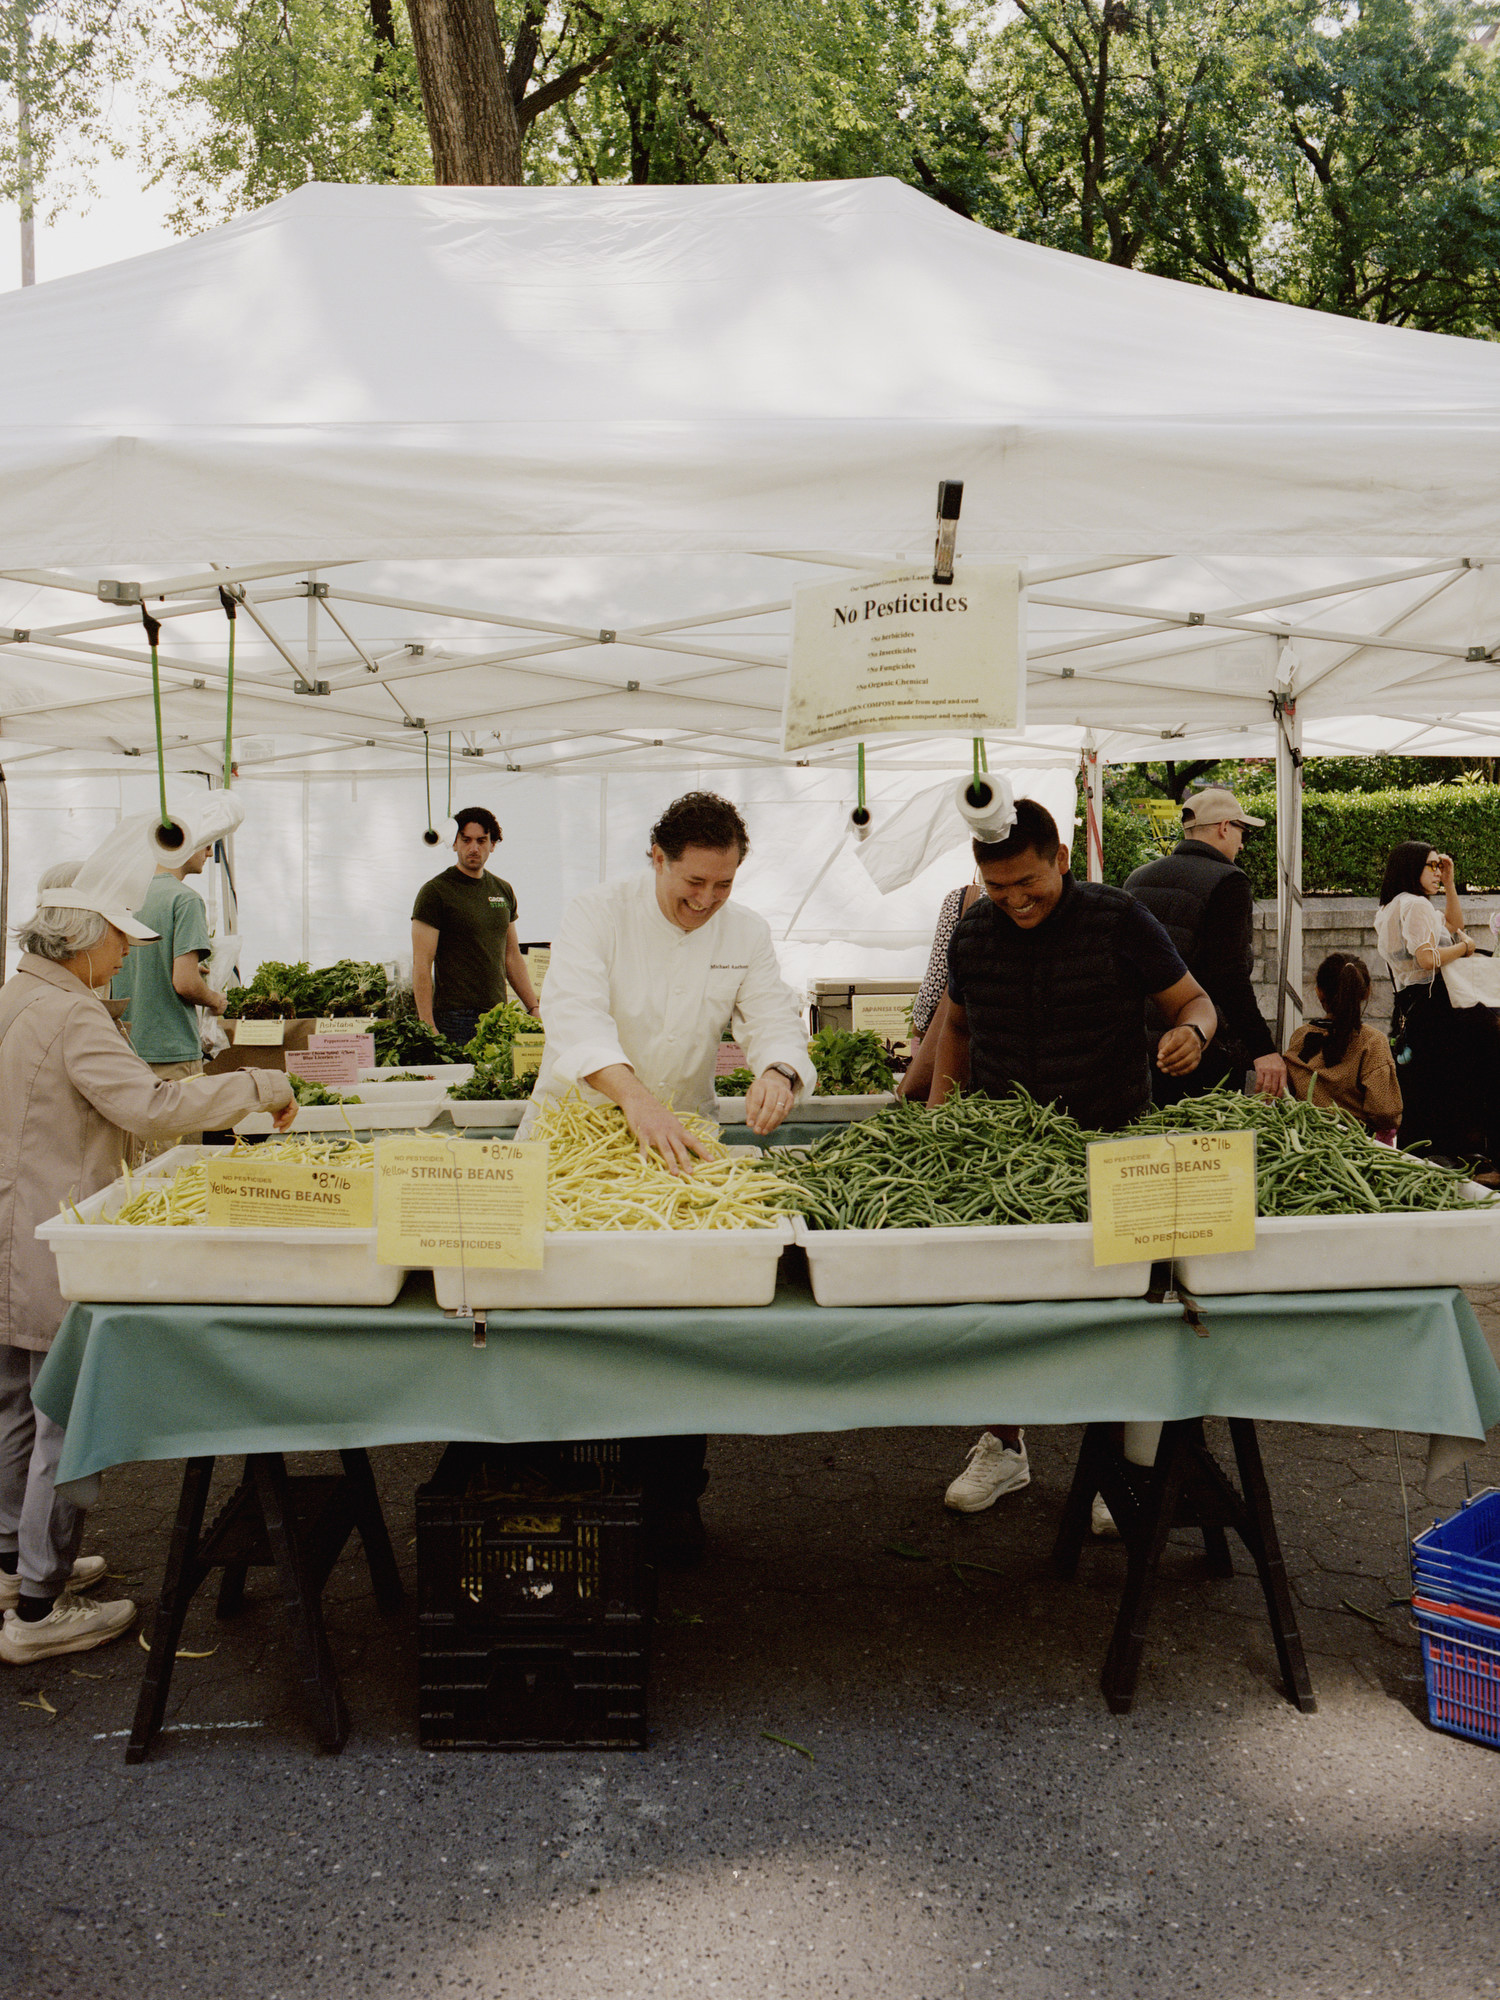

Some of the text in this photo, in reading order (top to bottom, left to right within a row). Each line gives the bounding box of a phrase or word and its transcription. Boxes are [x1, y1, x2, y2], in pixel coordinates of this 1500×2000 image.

[832, 592, 968, 628] No Pesticides
[1114, 1154, 1151, 1163] PESTICIDES
[380, 1165, 514, 1181] Yellow STRING BEANS
[1120, 1159, 1221, 1179] STRING BEANS
[234, 1175, 273, 1184] PESTICIDES
[209, 1181, 342, 1205] Yellow STRING BEANS
[420, 1239, 502, 1250] NO PESTICIDES
[1134, 1229, 1214, 1245] NO PESTICIDES
